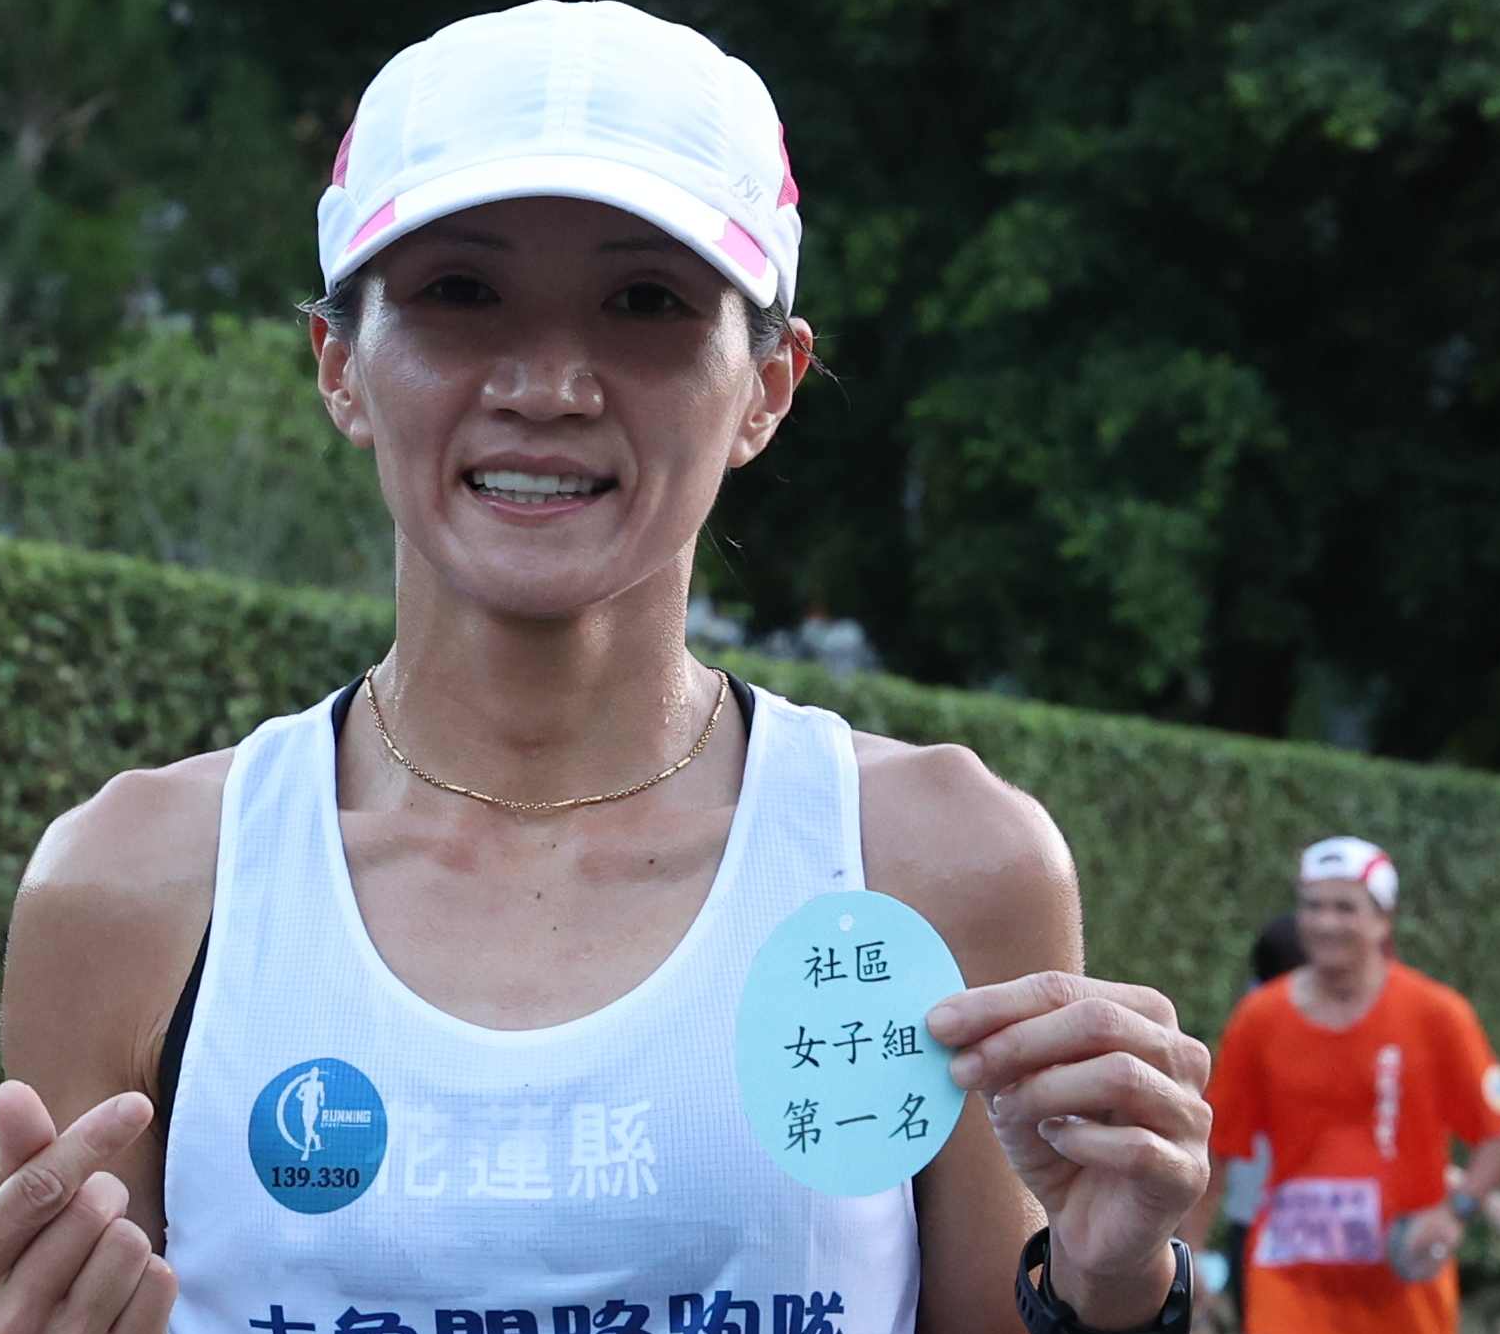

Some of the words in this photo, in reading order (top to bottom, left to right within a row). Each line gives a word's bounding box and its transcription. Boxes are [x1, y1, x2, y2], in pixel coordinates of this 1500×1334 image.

[803, 940, 892, 988] 社區
[783, 1020, 924, 1069] 女子組
[320, 1109, 372, 1124] RUNNING
[783, 1092, 930, 1154] 第一名
[271, 1167, 360, 1189] 139.330
